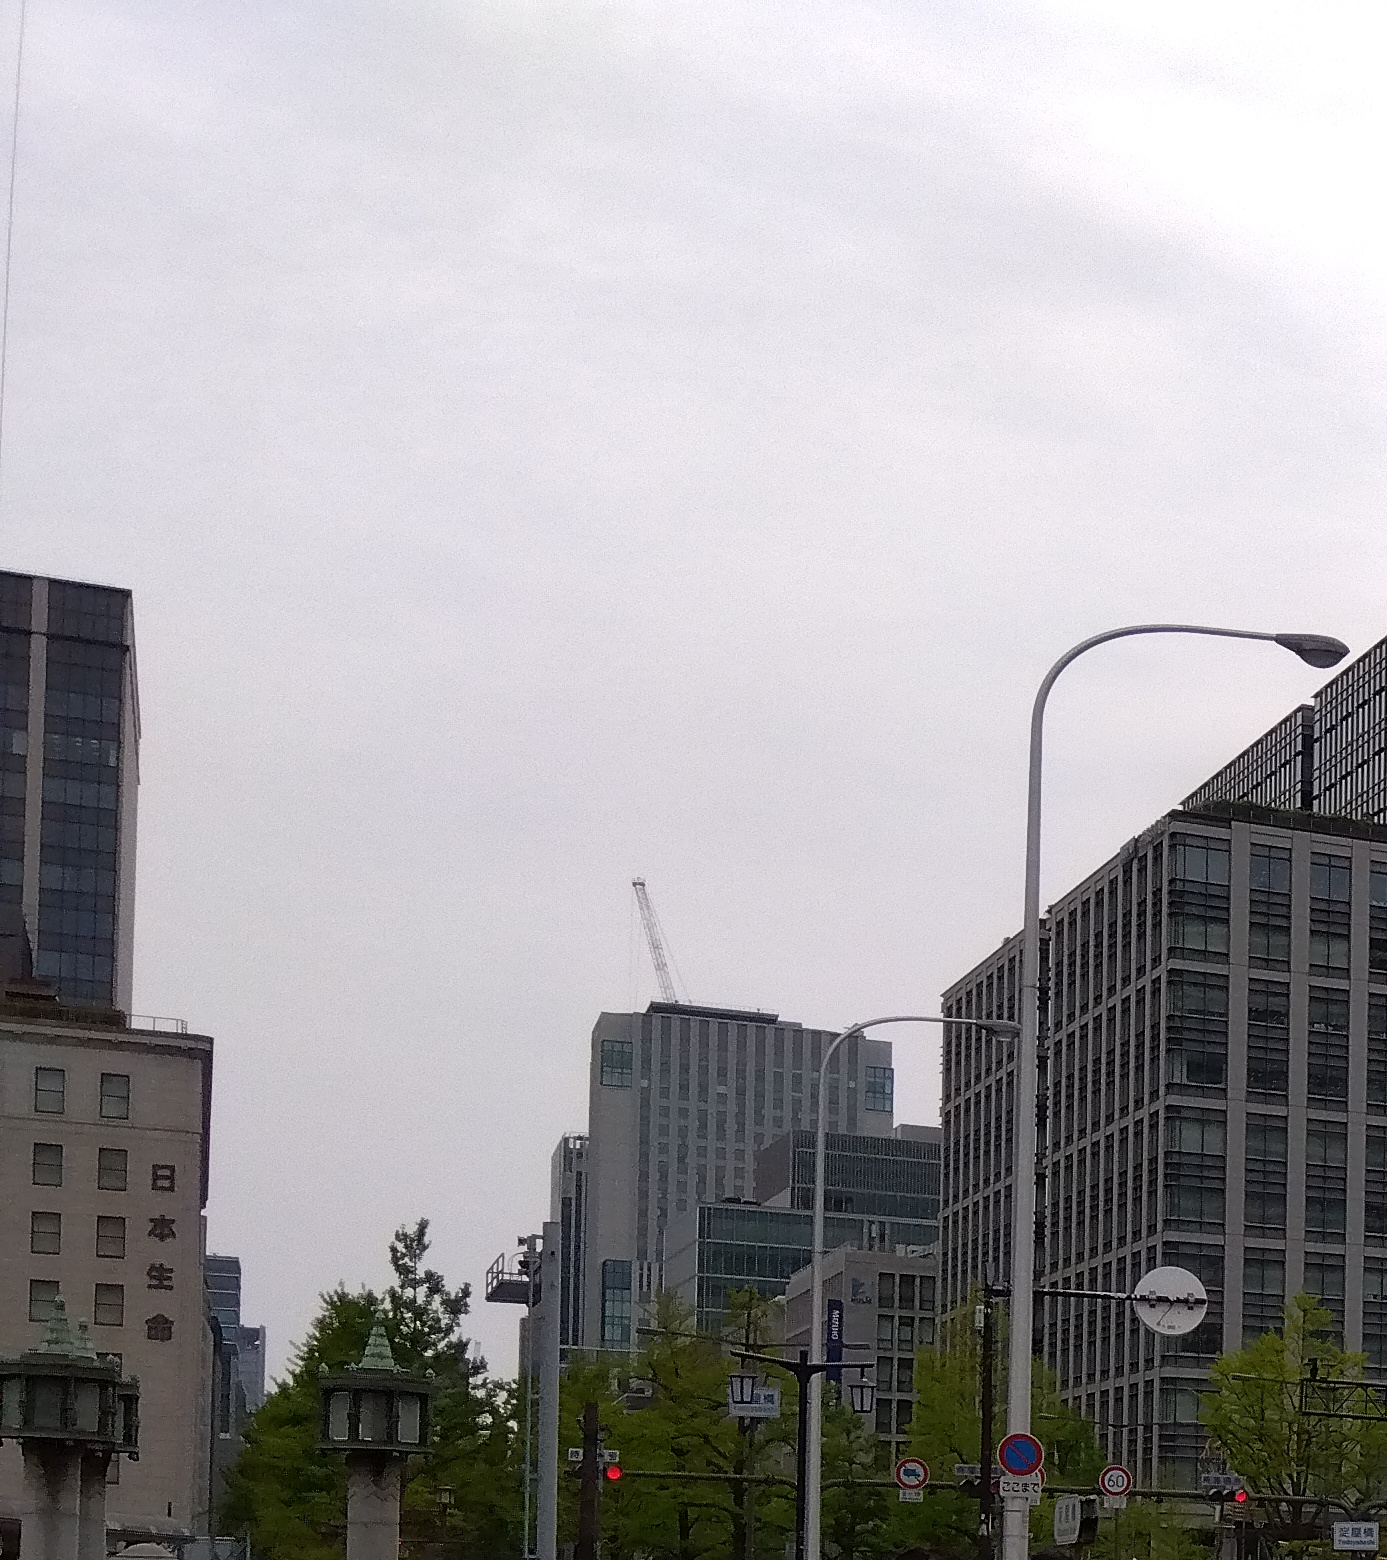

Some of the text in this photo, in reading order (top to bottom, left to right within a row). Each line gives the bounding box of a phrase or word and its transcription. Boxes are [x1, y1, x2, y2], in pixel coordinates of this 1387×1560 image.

[145, 1164, 177, 1341] 日本生命
[1002, 1481, 1040, 1493] ここまで
[1107, 1474, 1125, 1488] 60
